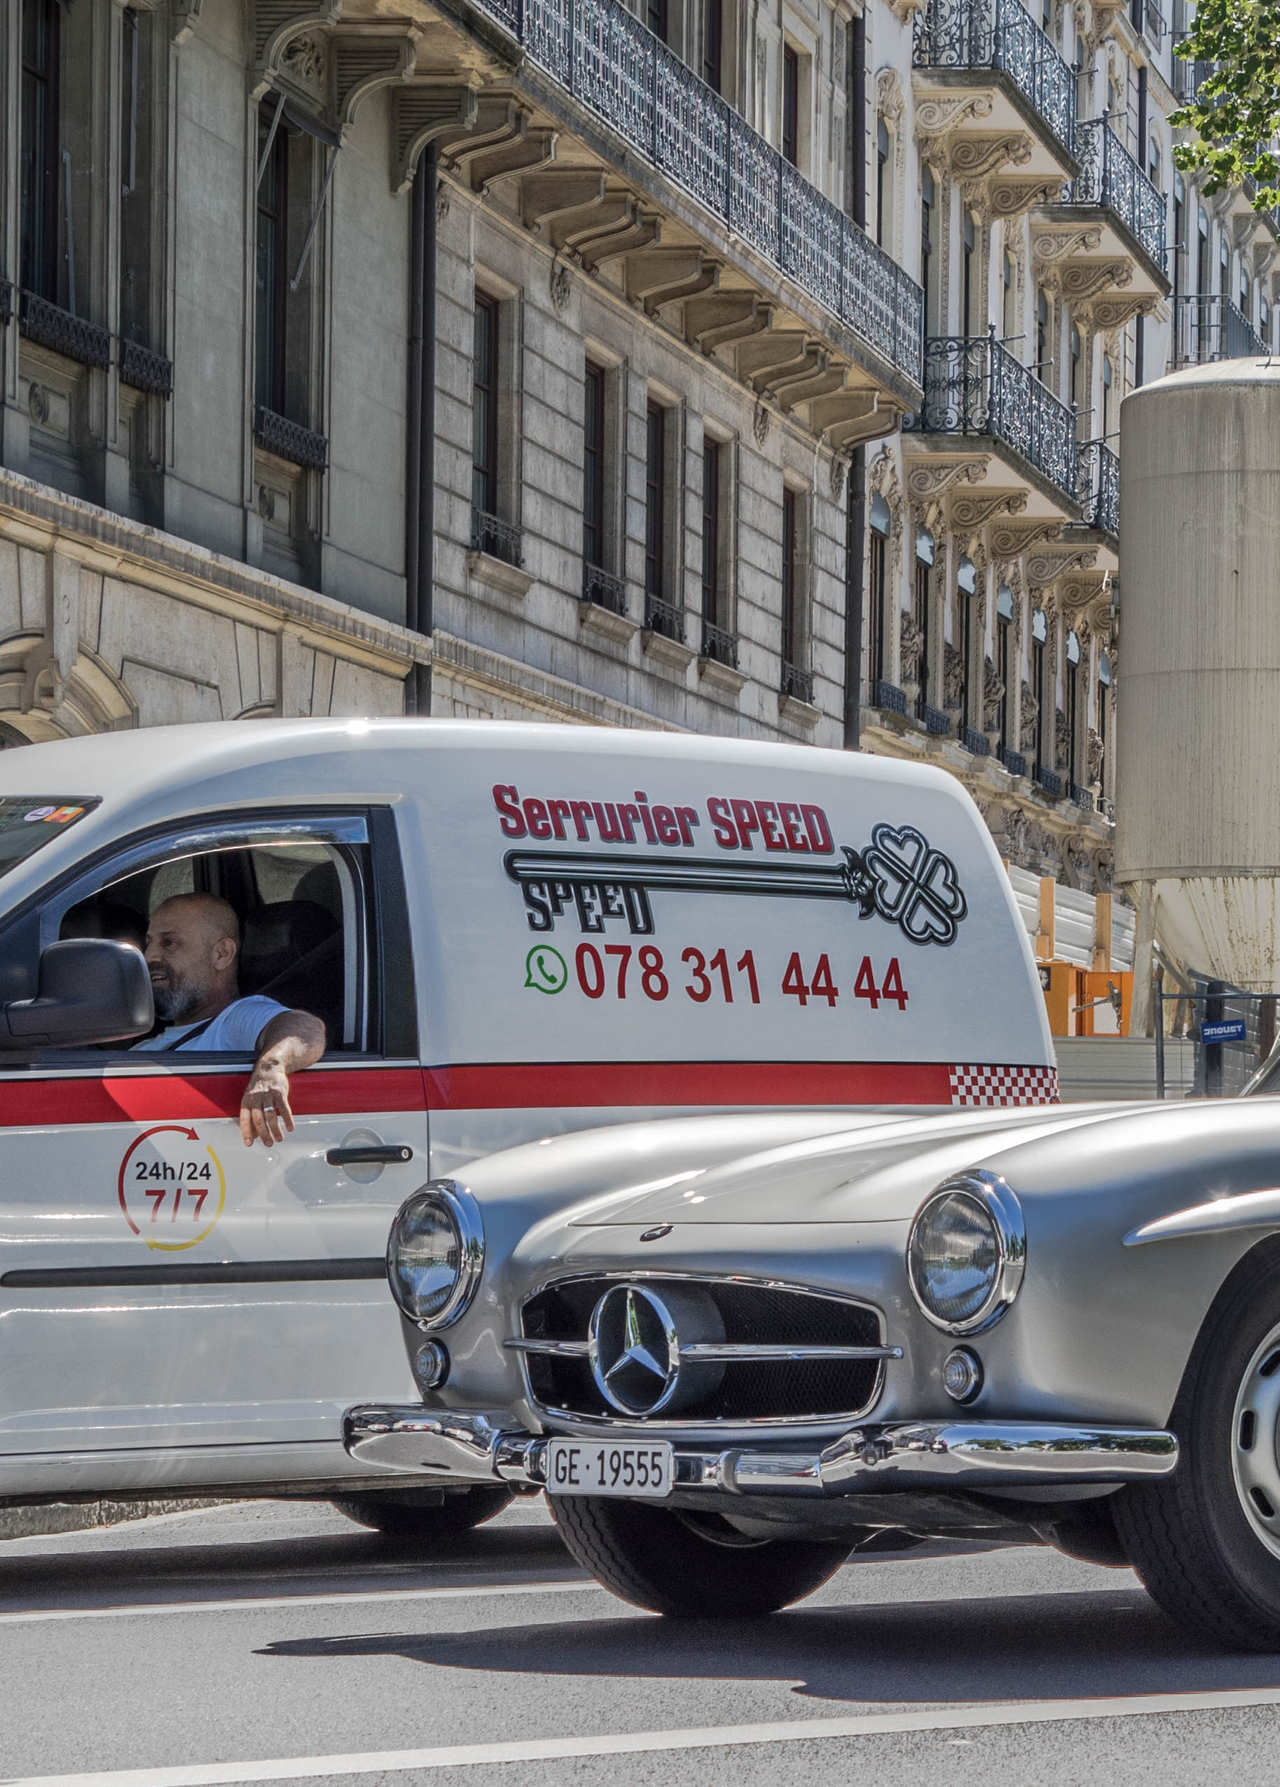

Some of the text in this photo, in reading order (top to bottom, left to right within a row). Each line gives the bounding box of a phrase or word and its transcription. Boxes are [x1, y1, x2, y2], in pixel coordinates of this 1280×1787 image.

[492, 784, 835, 855] Serrurier SPEED
[521, 881, 655, 935] SPEED
[575, 942, 909, 1011] 078 311 44 44
[135, 1161, 212, 1180] 24h/24
[145, 1188, 208, 1222] 7/7
[597, 1450, 663, 1488] 19555
